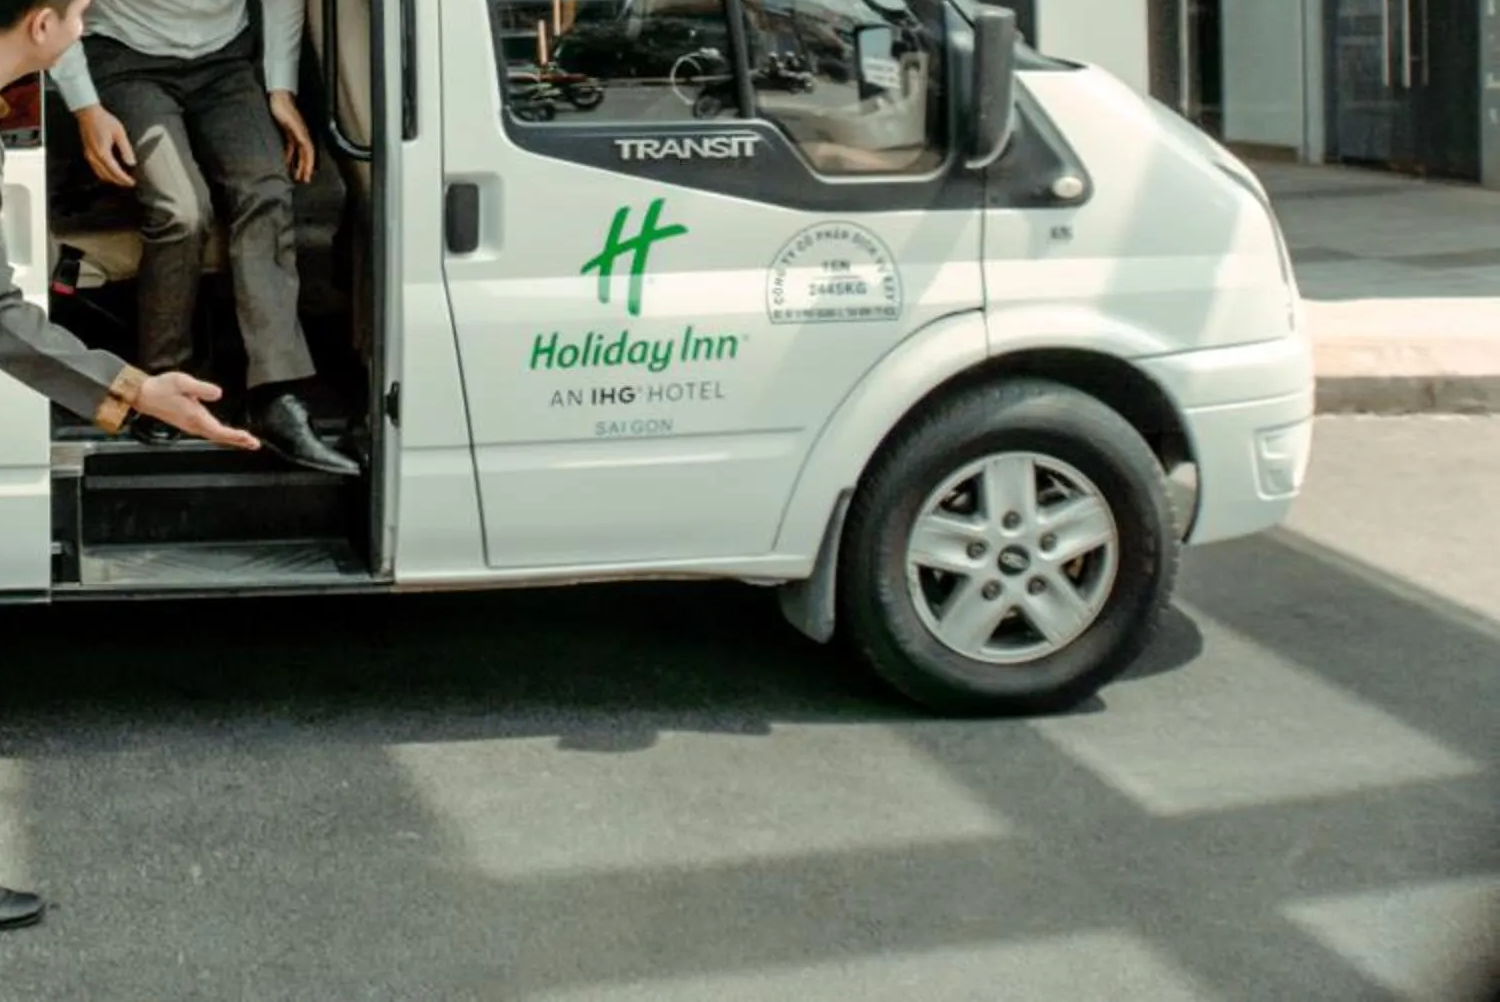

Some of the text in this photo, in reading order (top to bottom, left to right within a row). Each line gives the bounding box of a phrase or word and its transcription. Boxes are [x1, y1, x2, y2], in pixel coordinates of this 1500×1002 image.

[614, 135, 761, 160] TRANSIT
[530, 326, 738, 372] Holiday Inn
[550, 381, 725, 407] AN IHG HOTEL
[595, 418, 674, 436] SAIGON
